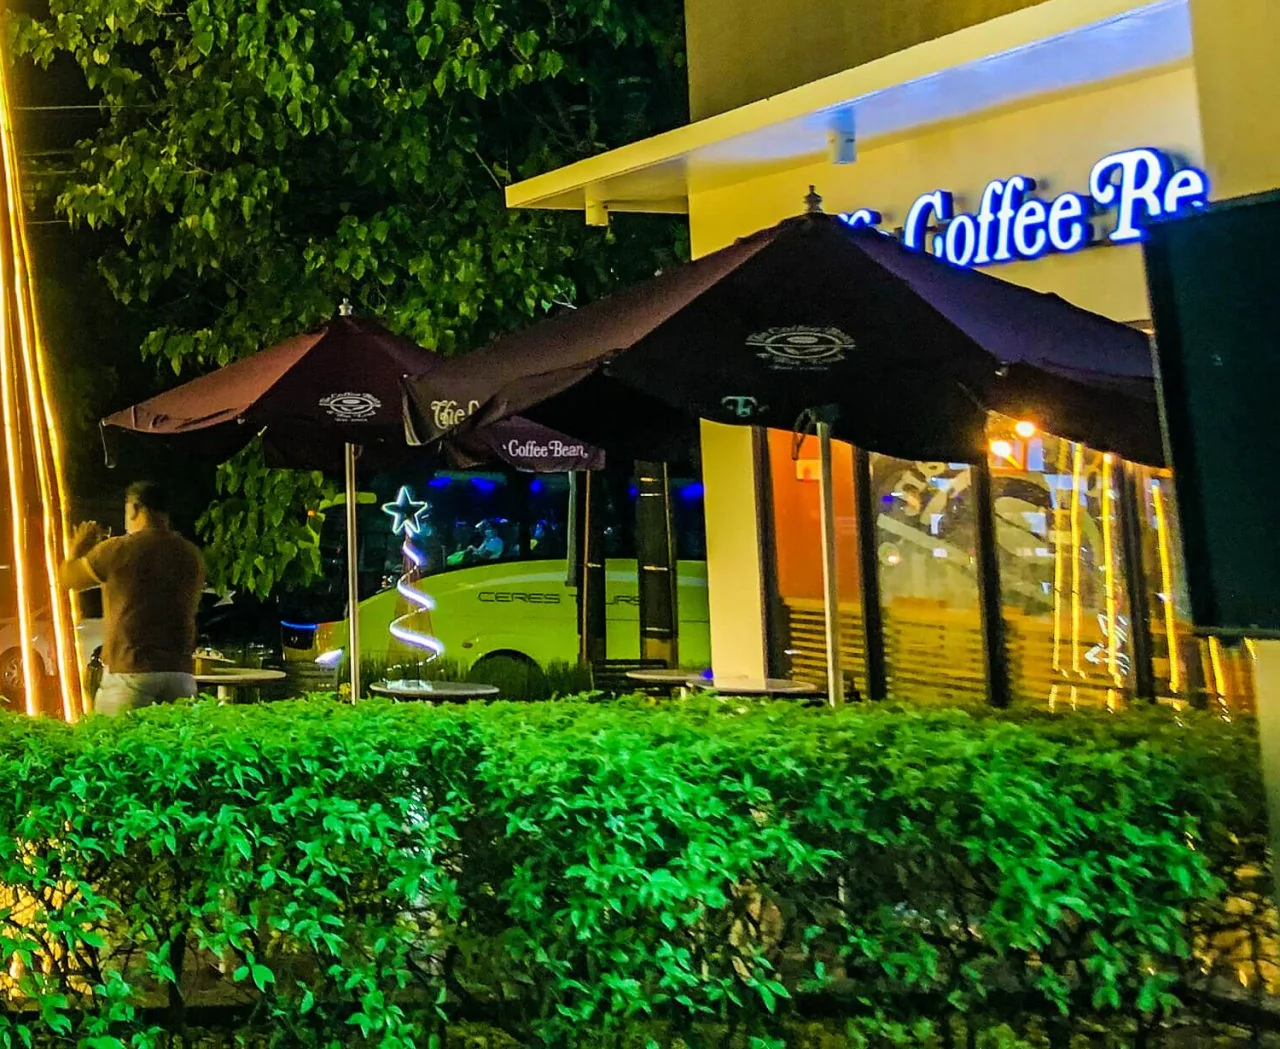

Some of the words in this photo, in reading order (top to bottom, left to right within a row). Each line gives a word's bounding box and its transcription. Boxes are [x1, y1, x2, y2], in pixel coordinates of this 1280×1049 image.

[904, 175, 1082, 266] Coffee
[431, 401, 465, 429] The
[508, 440, 548, 457] Coffee
[548, 440, 588, 458] Bean
[477, 591, 560, 604] CERES
